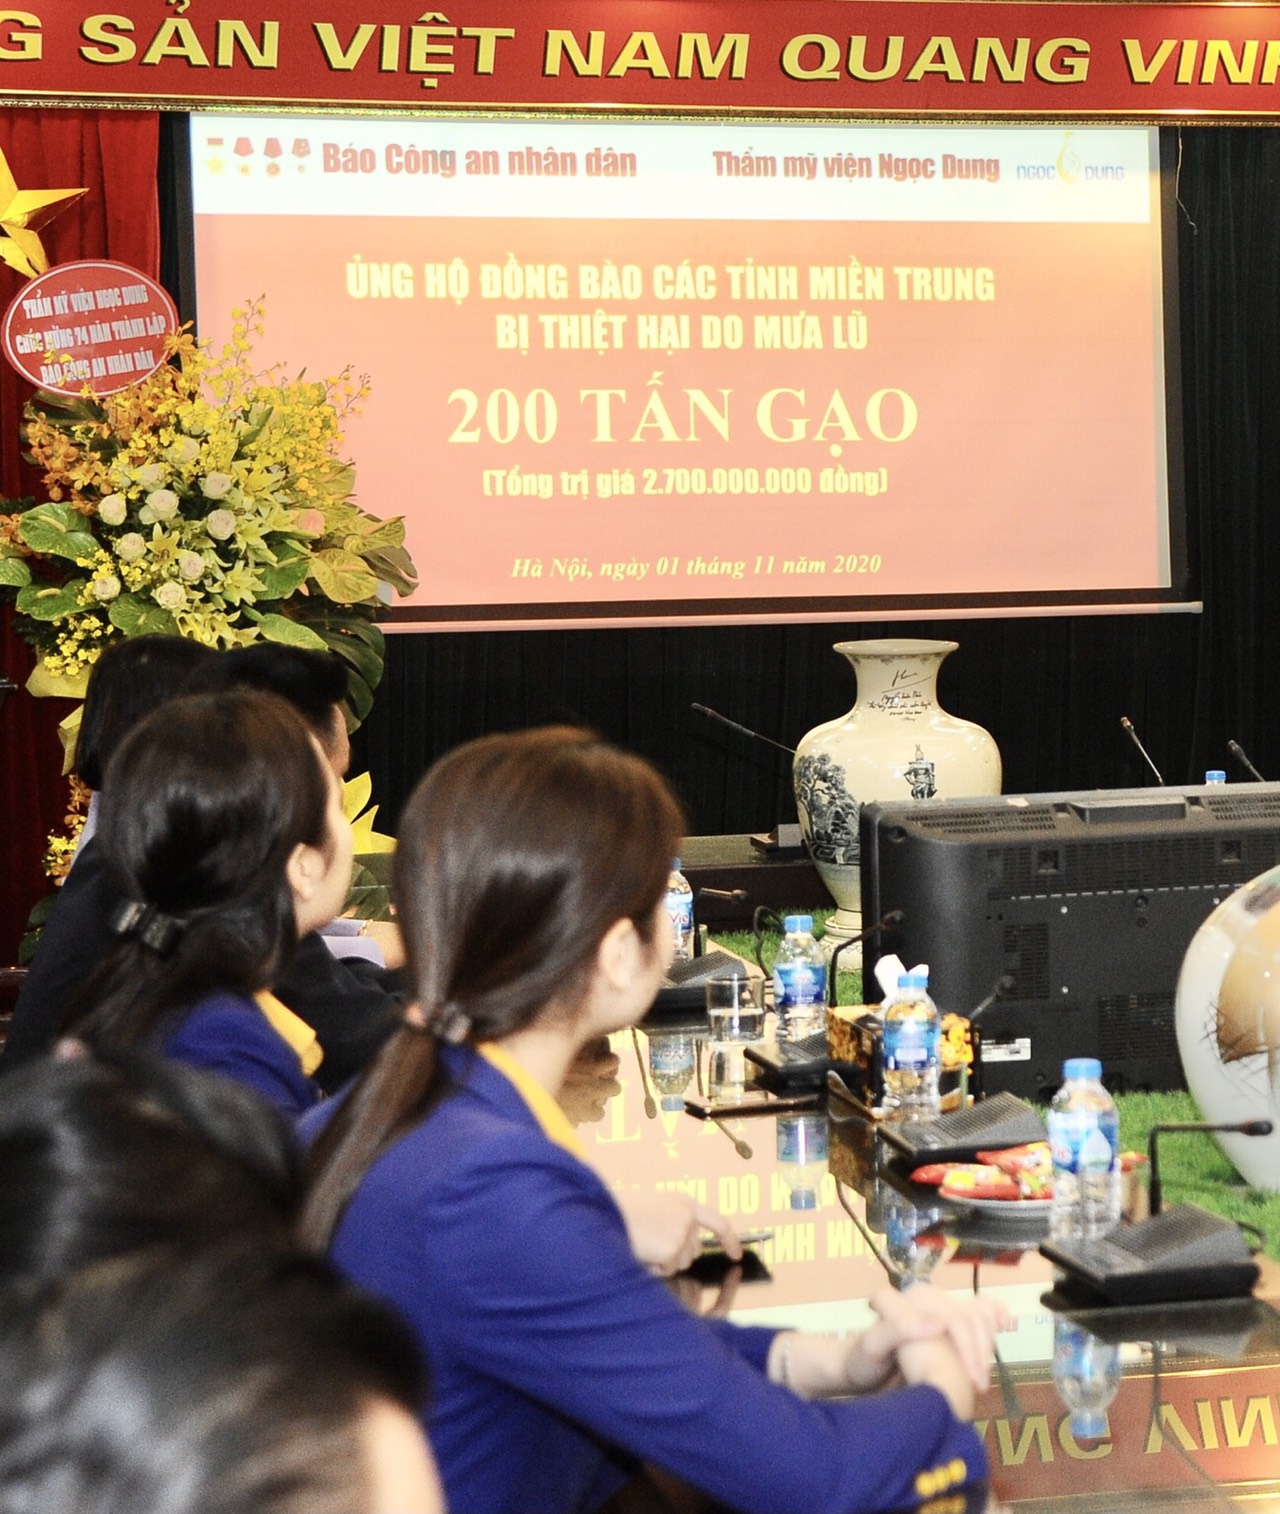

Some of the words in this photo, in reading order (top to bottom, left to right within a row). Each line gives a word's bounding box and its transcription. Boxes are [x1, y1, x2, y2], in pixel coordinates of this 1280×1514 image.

[80, 0, 280, 69] SẢN
[314, 12, 516, 88] VIỆT
[545, 30, 750, 79] NAM
[782, 33, 1091, 84] QUANG
[323, 143, 376, 174] Báo
[385, 143, 456, 178] Công
[465, 150, 499, 174] an
[508, 146, 577, 176] nhân
[585, 147, 637, 177] dân
[712, 147, 777, 178] Thẩm
[783, 153, 818, 180] mỹ
[823, 152, 872, 182] viện
[878, 153, 935, 182] Ngọc
[942, 154, 1000, 182] Dung
[121, 284, 149, 308] DUNG
[346, 253, 415, 300] ỦNG
[424, 257, 470, 306] HỘ
[479, 251, 569, 300] ĐỒNG
[578, 258, 643, 300] BÀO
[652, 259, 717, 300] CÁC
[725, 256, 799, 300] TỈNH
[808, 255, 885, 301] MIỀN
[893, 266, 996, 302] TRUNG
[75, 326, 90, 346] 74
[495, 313, 529, 356] BỊ
[538, 308, 628, 356] THIỆT
[637, 314, 691, 356] HẠI
[701, 314, 744, 350] DO
[754, 310, 823, 350] MƯA
[833, 309, 868, 350] LŨ
[447, 388, 558, 444] 200
[579, 371, 734, 443] TẤN
[756, 388, 918, 458] GẠO
[560, 469, 589, 500] trị
[597, 468, 636, 499] giá
[642, 467, 812, 496] 2.700.000.000
[511, 556, 543, 579] Hà
[549, 557, 594, 583] Nội,
[600, 558, 650, 581] ngày
[656, 557, 679, 576] 01
[686, 555, 746, 580] tháng
[753, 556, 776, 575] 11
[782, 557, 826, 575] năm
[833, 554, 882, 574] 2020
